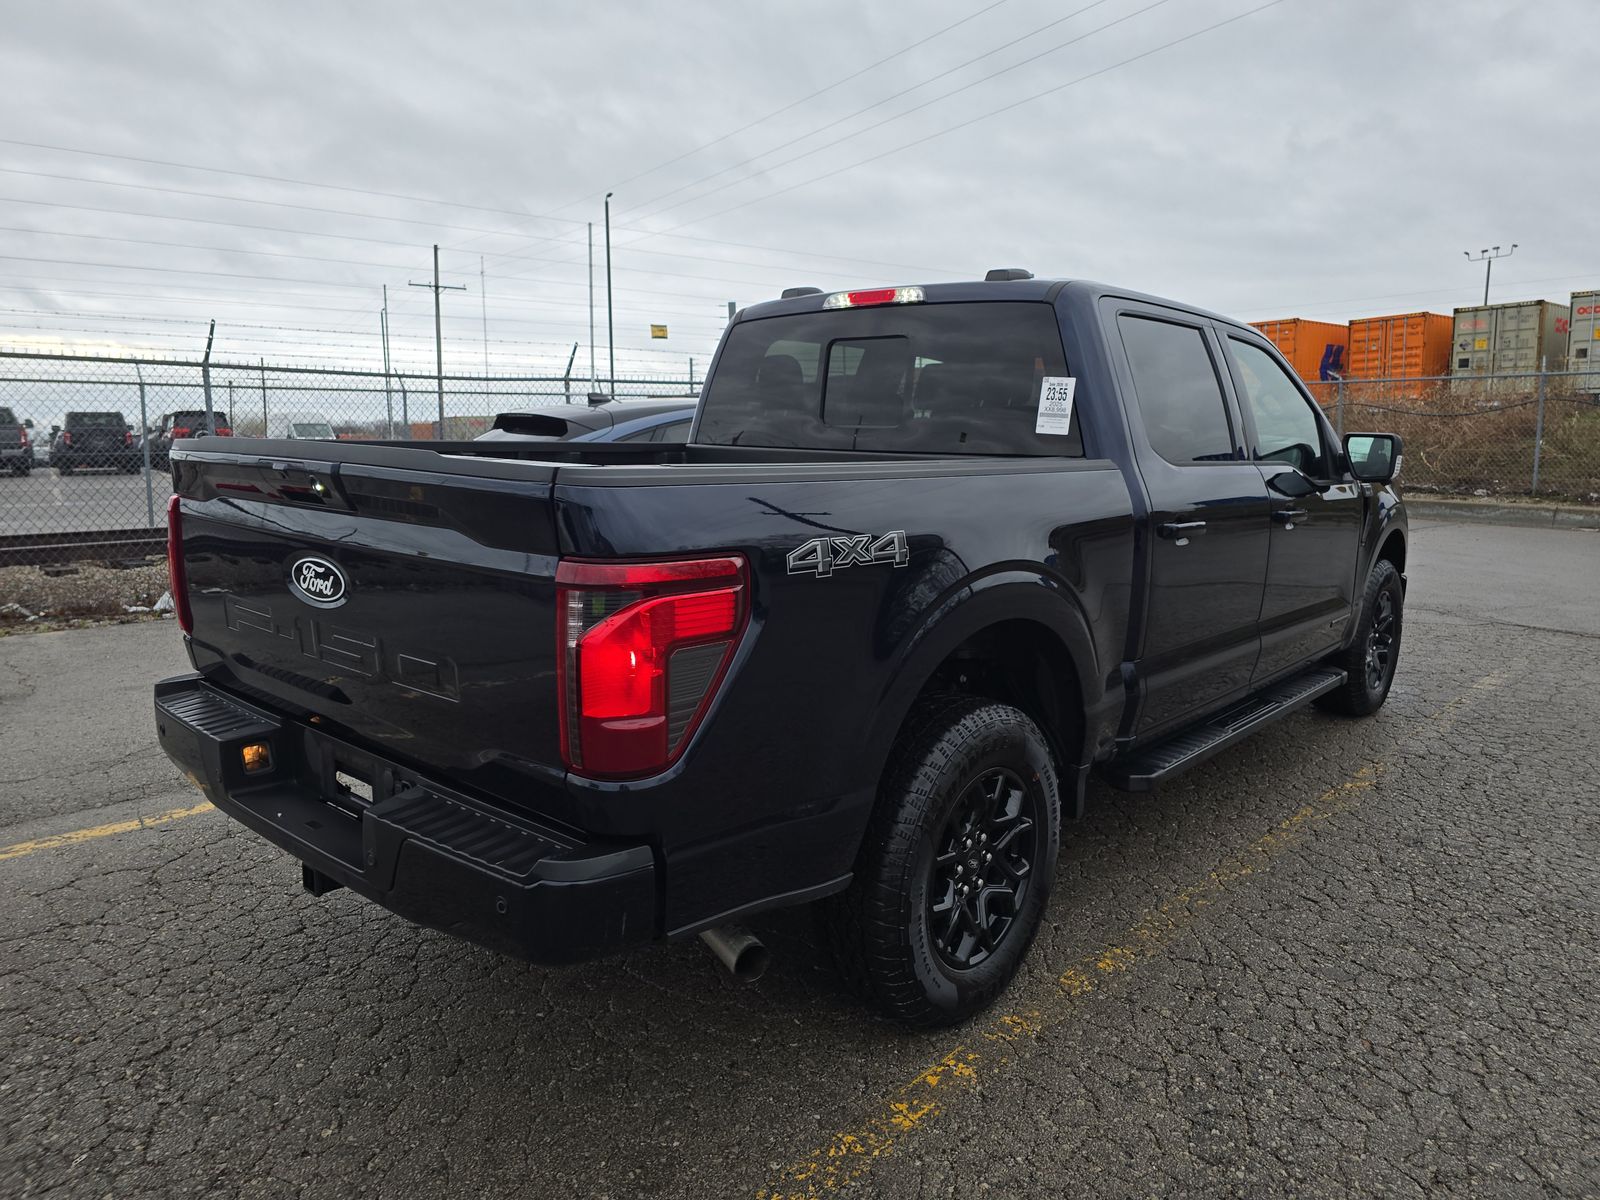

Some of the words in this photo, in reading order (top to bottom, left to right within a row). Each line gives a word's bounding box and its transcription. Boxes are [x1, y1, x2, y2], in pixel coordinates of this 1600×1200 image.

[1046, 387, 1068, 401] 23:55
[300, 562, 334, 595] Ford
[1041, 762, 1058, 821] TERRITORY
